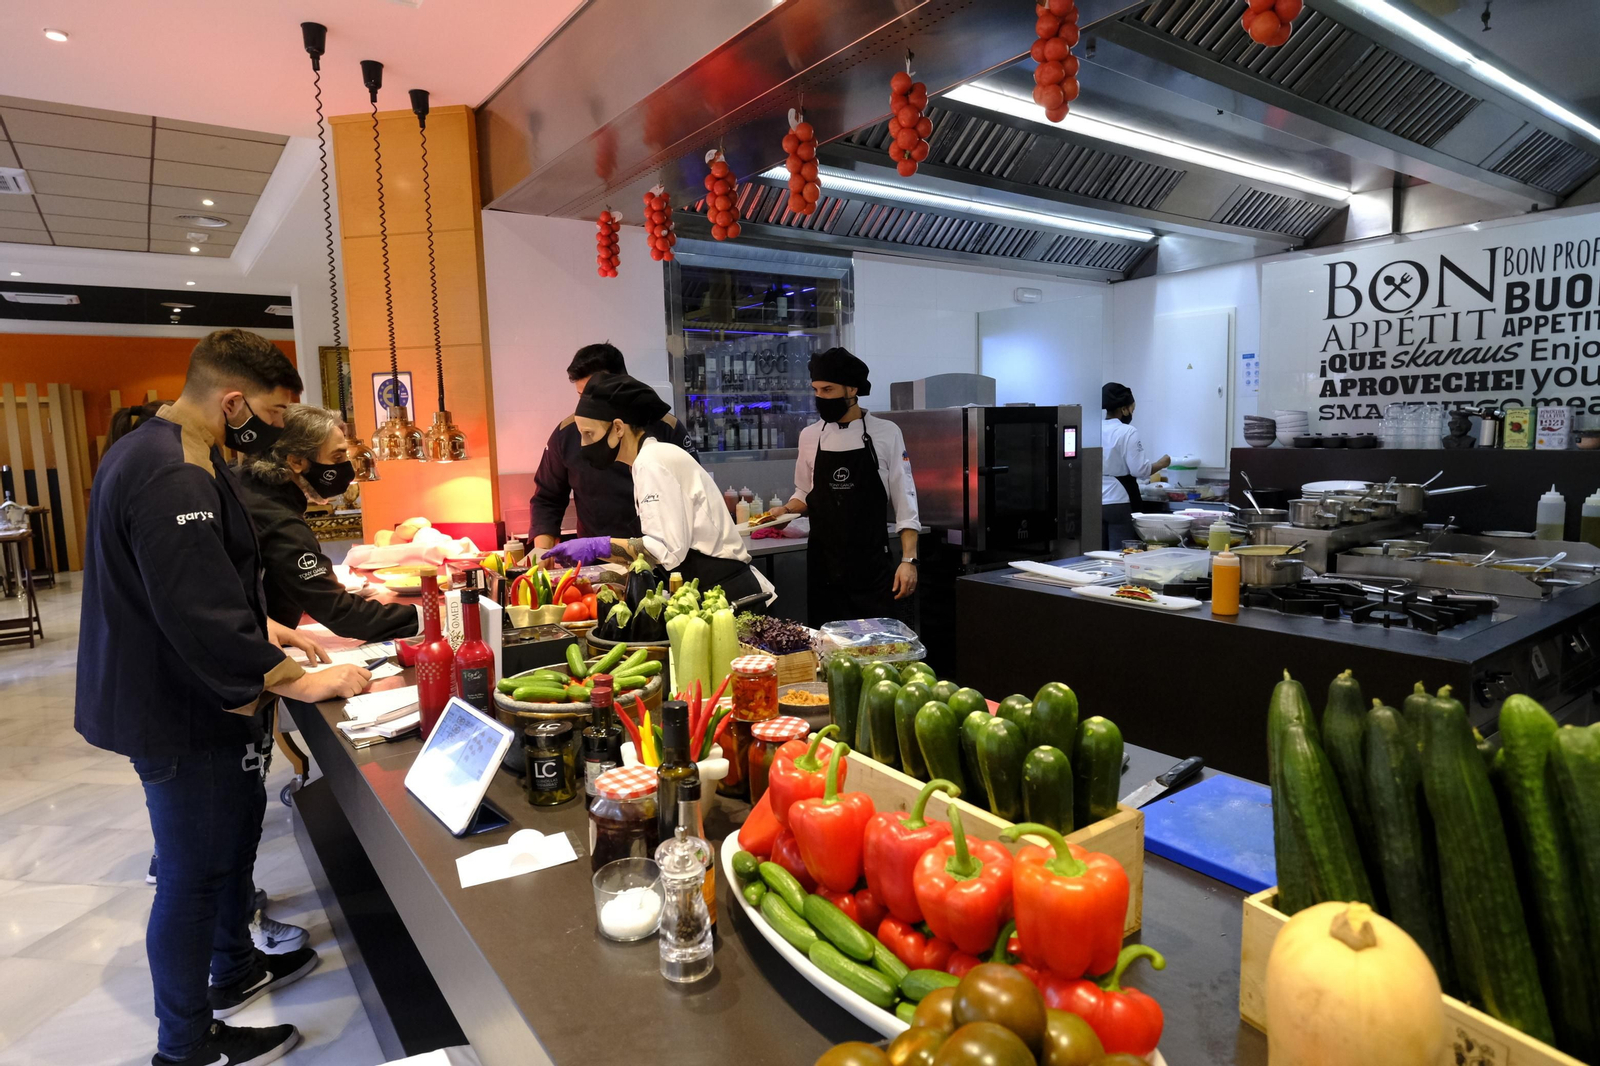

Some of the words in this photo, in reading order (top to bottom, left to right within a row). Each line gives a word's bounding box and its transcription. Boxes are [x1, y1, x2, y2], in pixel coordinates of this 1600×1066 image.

[1504, 245, 1546, 277] BON
[1322, 246, 1502, 321] BON
[1504, 273, 1600, 315] BUO
[1319, 308, 1496, 352] APPÉTIT
[1390, 337, 1524, 369] skanaus
[1530, 336, 1600, 365] Enjo
[1318, 369, 1526, 398] APROVECHE!
[176, 511, 214, 525] gary's
[534, 762, 557, 778] LC
